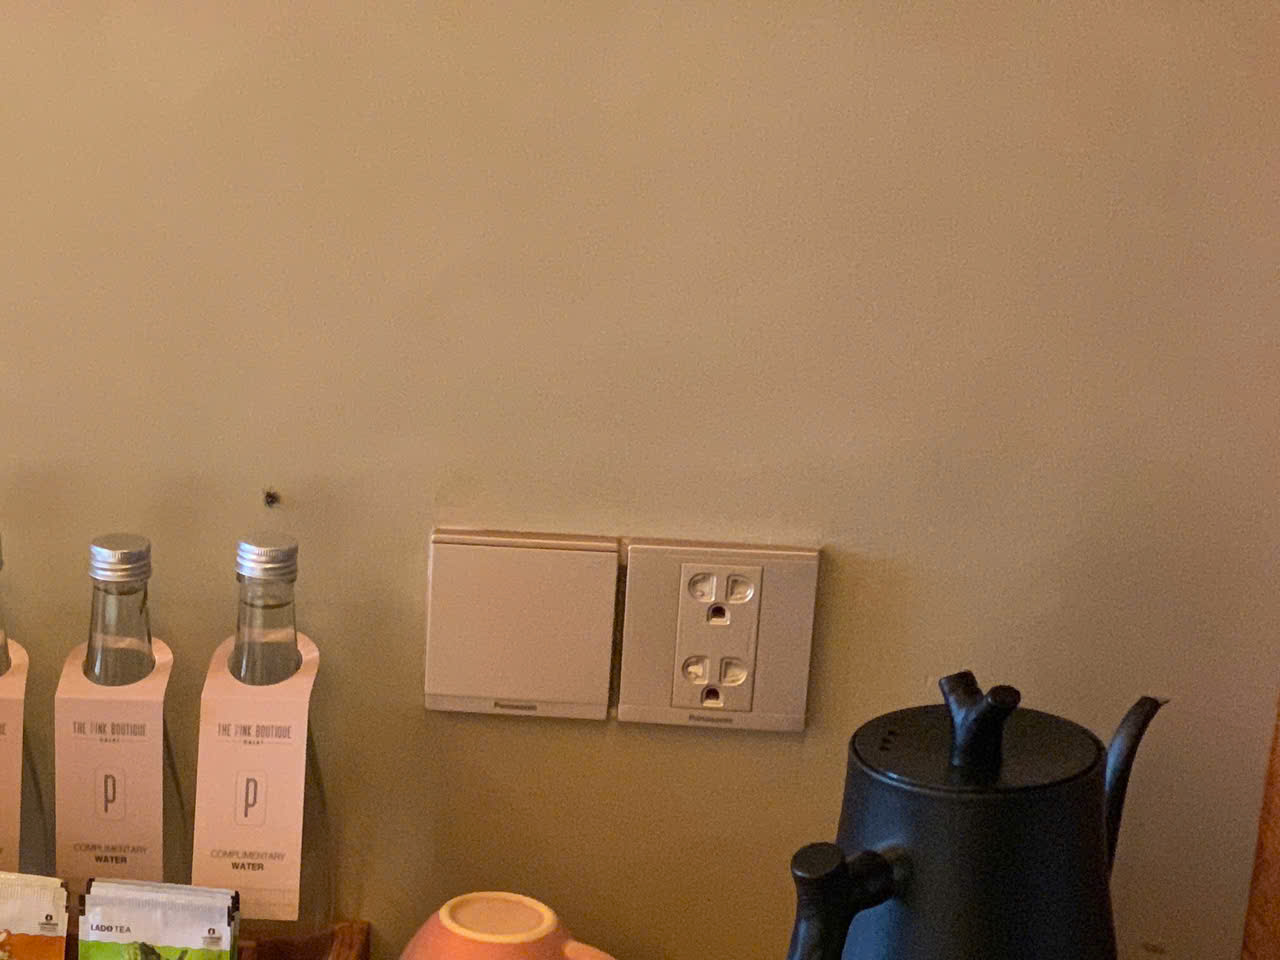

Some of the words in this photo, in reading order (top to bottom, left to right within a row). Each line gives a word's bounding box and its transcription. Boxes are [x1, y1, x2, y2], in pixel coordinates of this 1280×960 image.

[217, 723, 231, 737] THE
[255, 725, 293, 740] BOUTIQUE
[244, 776, 258, 818] P
[94, 855, 128, 865] WATER
[231, 862, 265, 872] WATER
[114, 924, 132, 934] TEA
